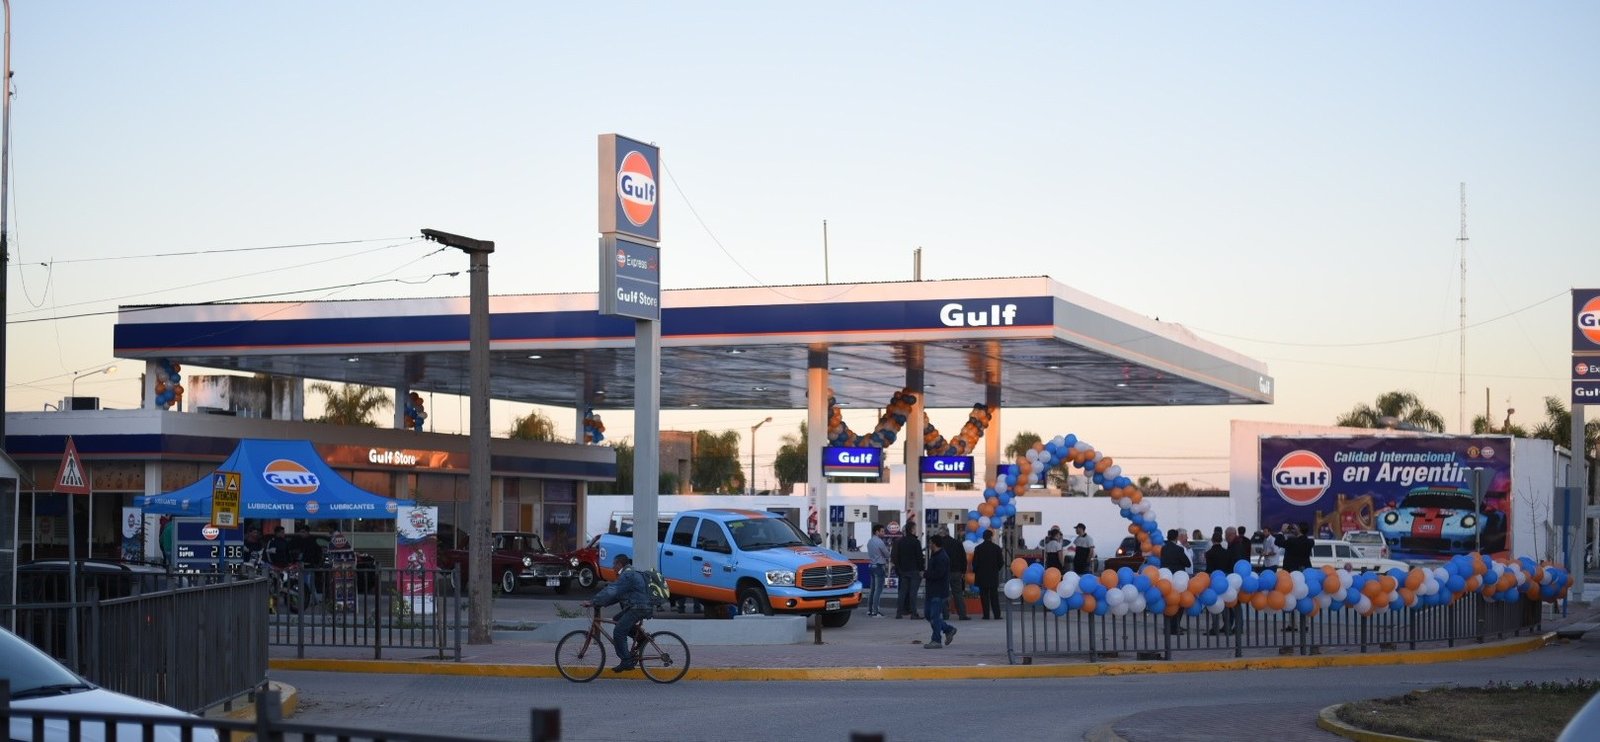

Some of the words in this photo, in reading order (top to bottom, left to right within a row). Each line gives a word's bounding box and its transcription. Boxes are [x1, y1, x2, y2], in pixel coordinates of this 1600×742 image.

[621, 174, 655, 202] Gulf
[626, 255, 648, 270] Express
[617, 287, 638, 304] Gulf
[639, 291, 657, 308] Store
[939, 303, 1018, 327] Gulf
[1575, 387, 1600, 397] Gul
[368, 448, 394, 464] Gulf
[394, 450, 416, 465] Store
[838, 452, 873, 464] Gulf
[1334, 451, 1377, 463] Calidad
[1379, 451, 1456, 463] Internacional
[933, 460, 965, 472] Gulf
[265, 473, 319, 486] Gulf
[1275, 471, 1328, 486] Gulf
[1342, 465, 1370, 482] en
[1375, 463, 1484, 486] Argentin
[247, 502, 294, 511] LUBRICANTES
[330, 503, 375, 512] LUBRICANTES
